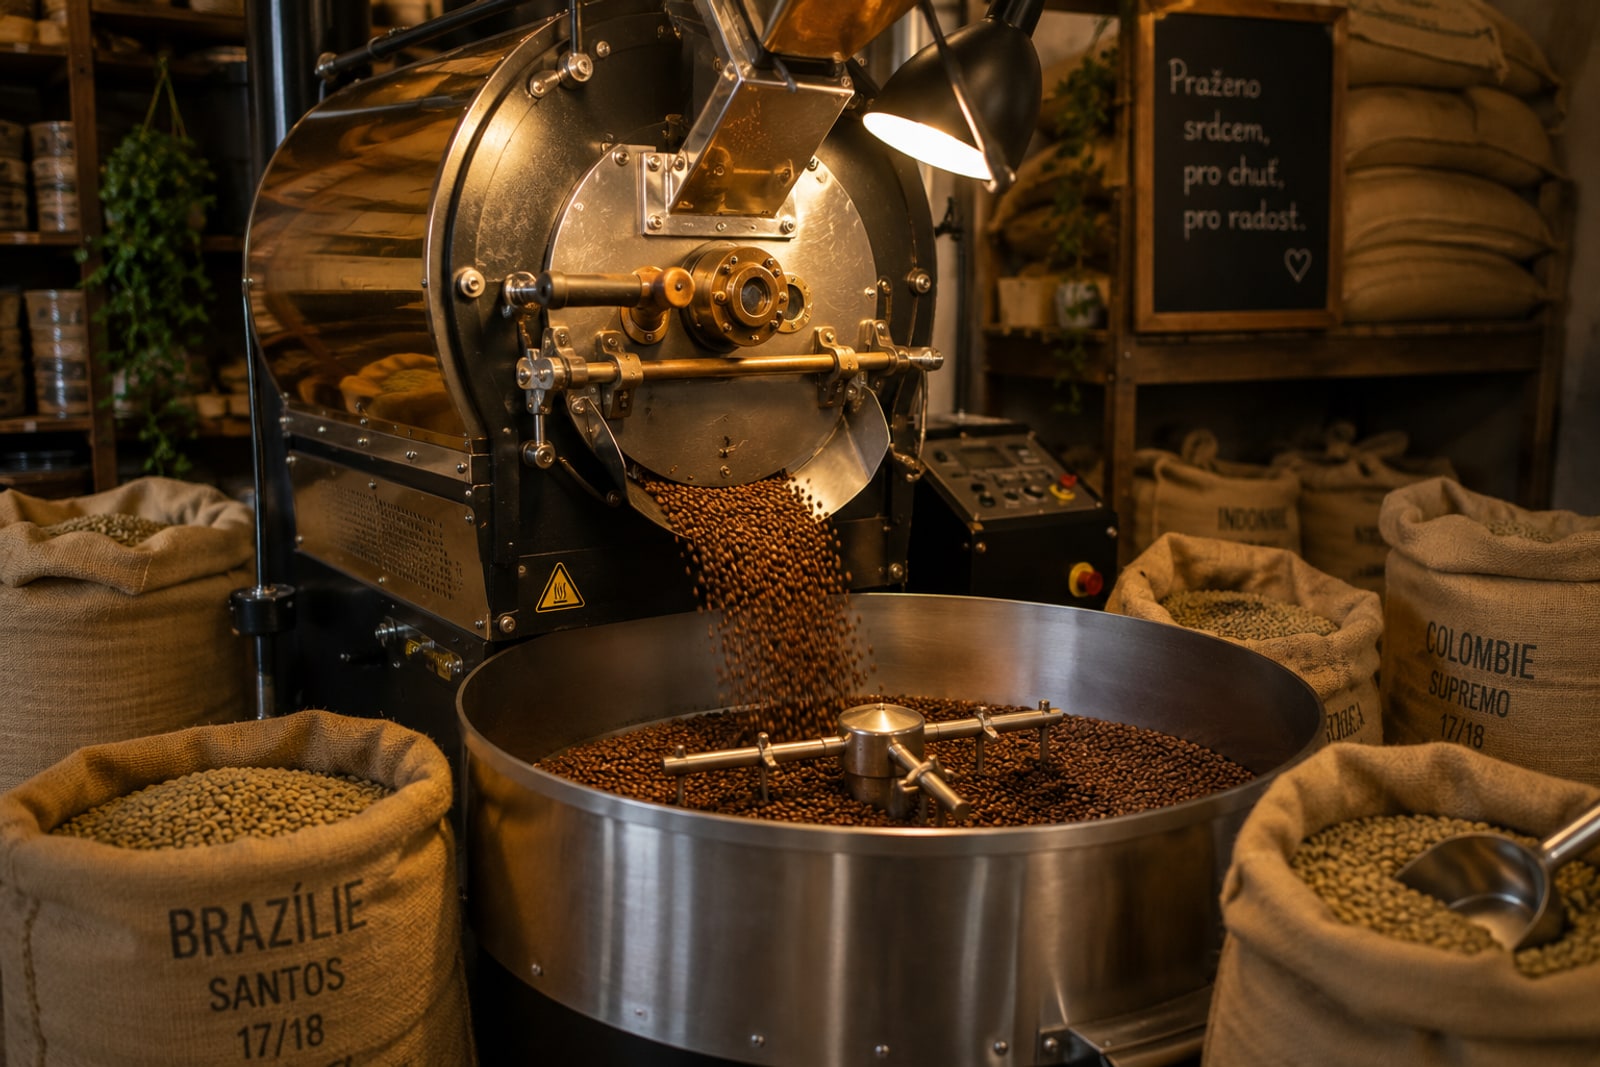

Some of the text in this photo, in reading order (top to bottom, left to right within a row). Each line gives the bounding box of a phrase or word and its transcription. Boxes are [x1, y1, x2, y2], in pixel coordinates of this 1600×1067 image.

[1168, 57, 1261, 98] Praženo
[1183, 110, 1270, 146] srdcem,
[1183, 165, 1221, 196] pro
[1183, 199, 1306, 240] pro radost.
[1426, 621, 1537, 680] COLOMBIE
[1428, 670, 1510, 718] SUPREMO
[1440, 713, 1485, 749] 17/18
[168, 879, 368, 959] BRAZÍLIE
[208, 957, 346, 1012] SANTOS
[237, 1013, 325, 1060] 17/18
